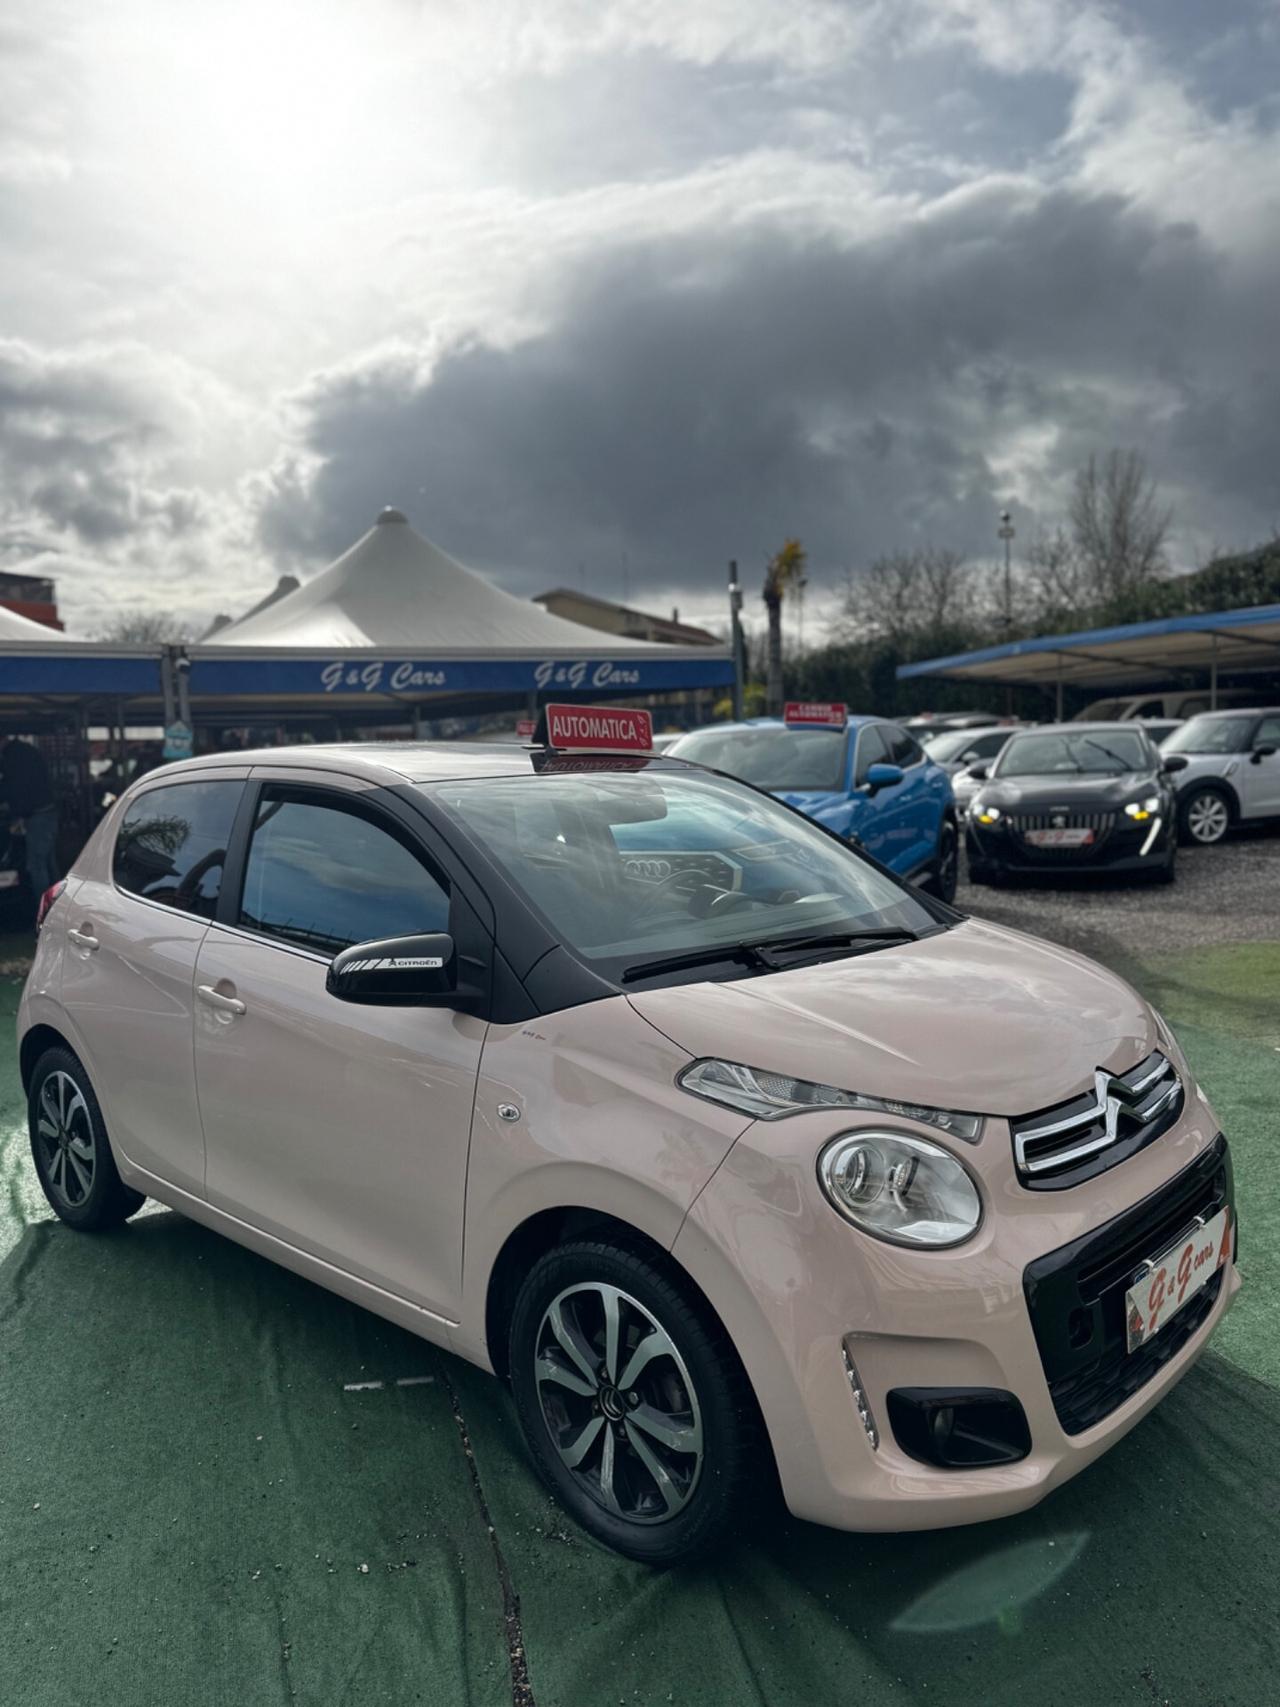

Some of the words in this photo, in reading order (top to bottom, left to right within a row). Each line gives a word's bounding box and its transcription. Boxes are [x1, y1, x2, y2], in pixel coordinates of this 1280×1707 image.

[390, 662, 446, 689] Cars
[592, 662, 640, 687] Cars
[553, 715, 638, 740] AUTOMATICA
[1194, 1241, 1214, 1271] cars
